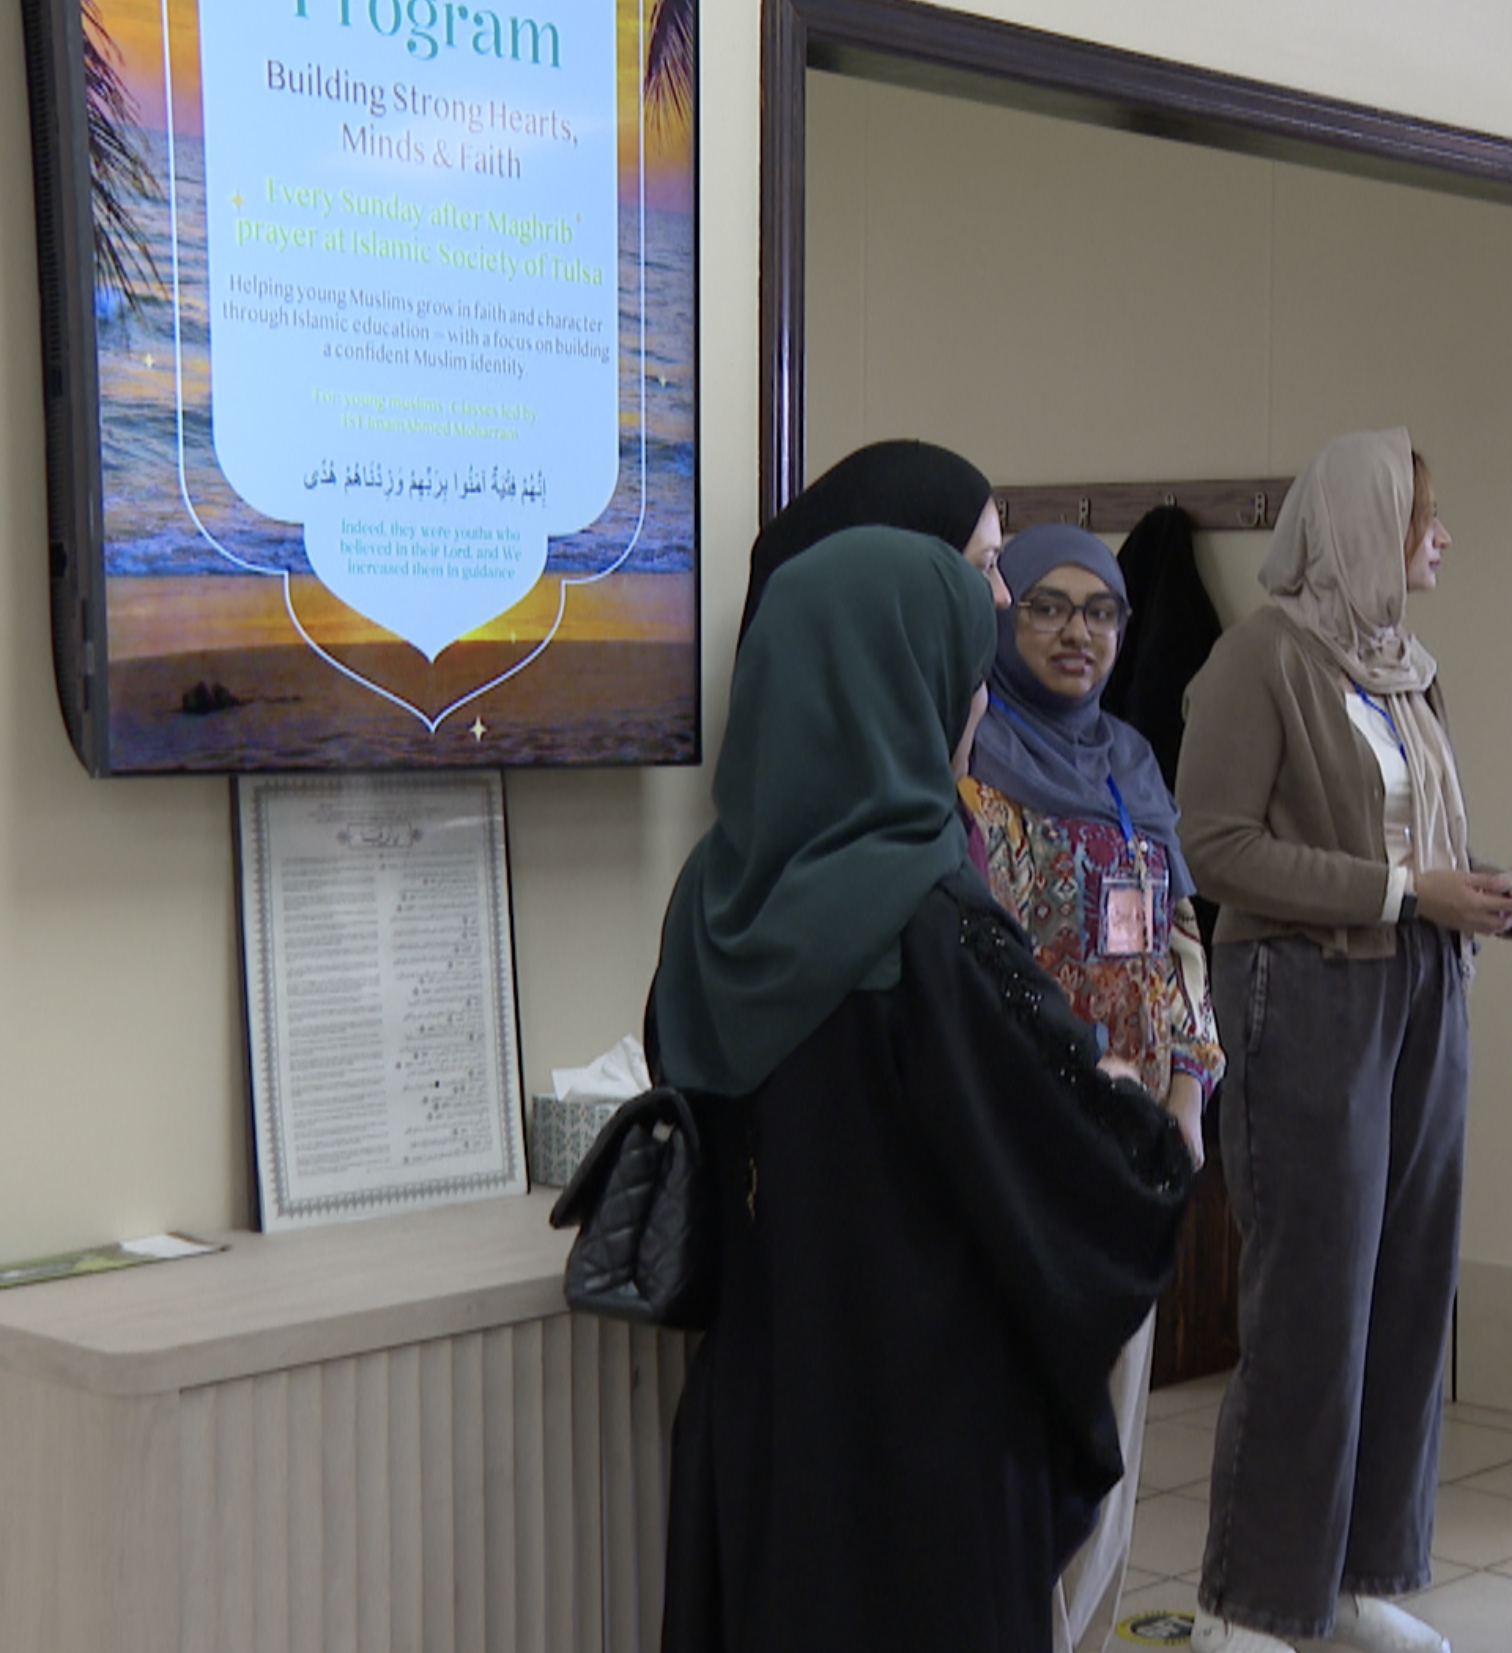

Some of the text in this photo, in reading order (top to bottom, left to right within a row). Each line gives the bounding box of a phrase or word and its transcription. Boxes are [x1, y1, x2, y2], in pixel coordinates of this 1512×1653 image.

[294, 0, 562, 68] ogram
[266, 58, 578, 149] Building Strong Hearts,
[342, 122, 521, 180] Minds & Faith
[266, 176, 573, 245] Every Sunday after Maghrib
[236, 219, 603, 285] prayer at Islamic Society of Tulsa
[223, 301, 289, 329] through
[293, 309, 349, 333] Islamic
[352, 315, 429, 341] education
[447, 326, 479, 347] with
[482, 333, 491, 347] a
[493, 331, 532, 351] focus
[535, 338, 553, 353] on
[555, 337, 610, 364] building
[229, 274, 603, 333] Helping young Muslims grow in faith and character
[323, 342, 331, 358] a
[335, 341, 410, 365] confident
[413, 350, 468, 371] Muslim
[343, 393, 385, 413] young
[450, 397, 498, 417] Classes
[500, 402, 520, 420] led
[522, 404, 539, 426] by
[367, 414, 405, 436] Imam
[339, 539, 392, 556] believed
[396, 542, 408, 557] in
[411, 542, 439, 558] their
[476, 545, 499, 561] and
[502, 545, 522, 562] We
[390, 520, 416, 541] they
[420, 524, 450, 540] were
[454, 525, 493, 543] youths
[496, 526, 521, 542] who
[412, 560, 443, 578] them
[447, 561, 459, 578] in
[462, 563, 515, 581] guidance
